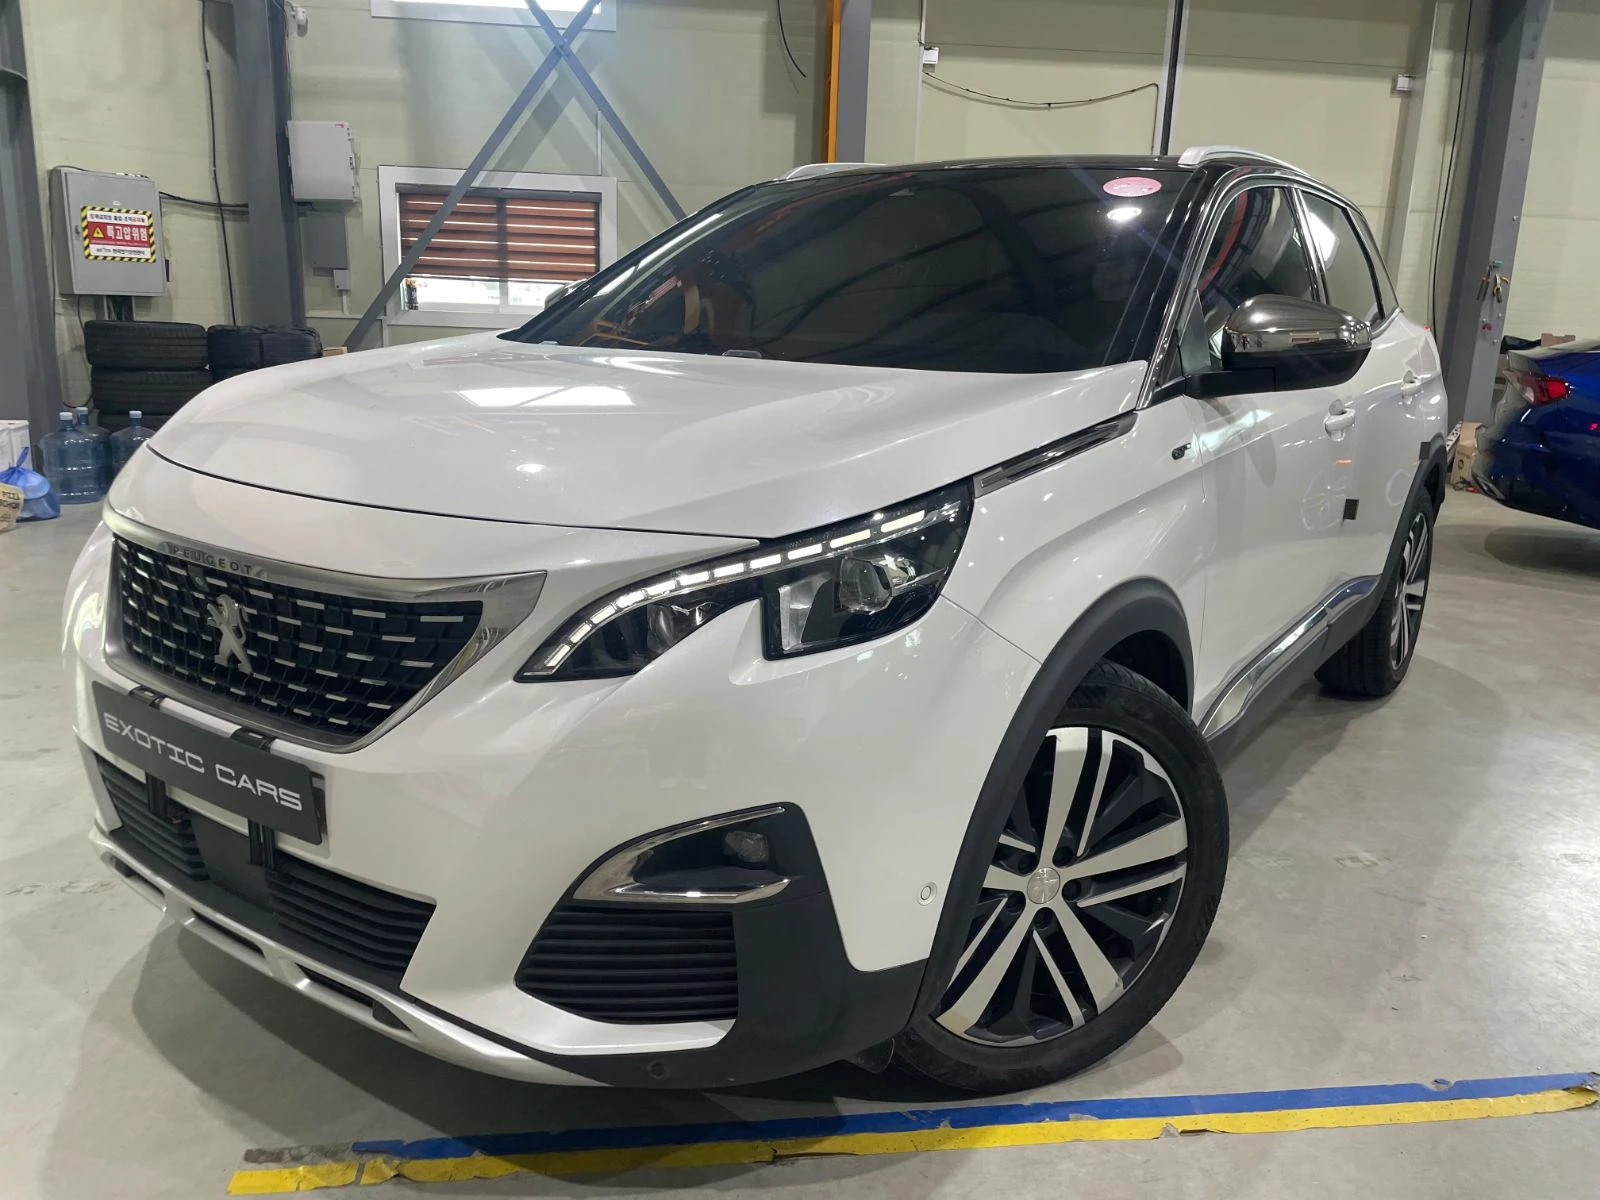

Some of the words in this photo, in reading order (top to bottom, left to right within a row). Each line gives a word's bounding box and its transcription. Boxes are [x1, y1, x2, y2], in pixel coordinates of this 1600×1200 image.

[173, 544, 252, 575] PEUGEOT
[103, 712, 205, 773] EXOTIC
[215, 763, 302, 811] CARS
